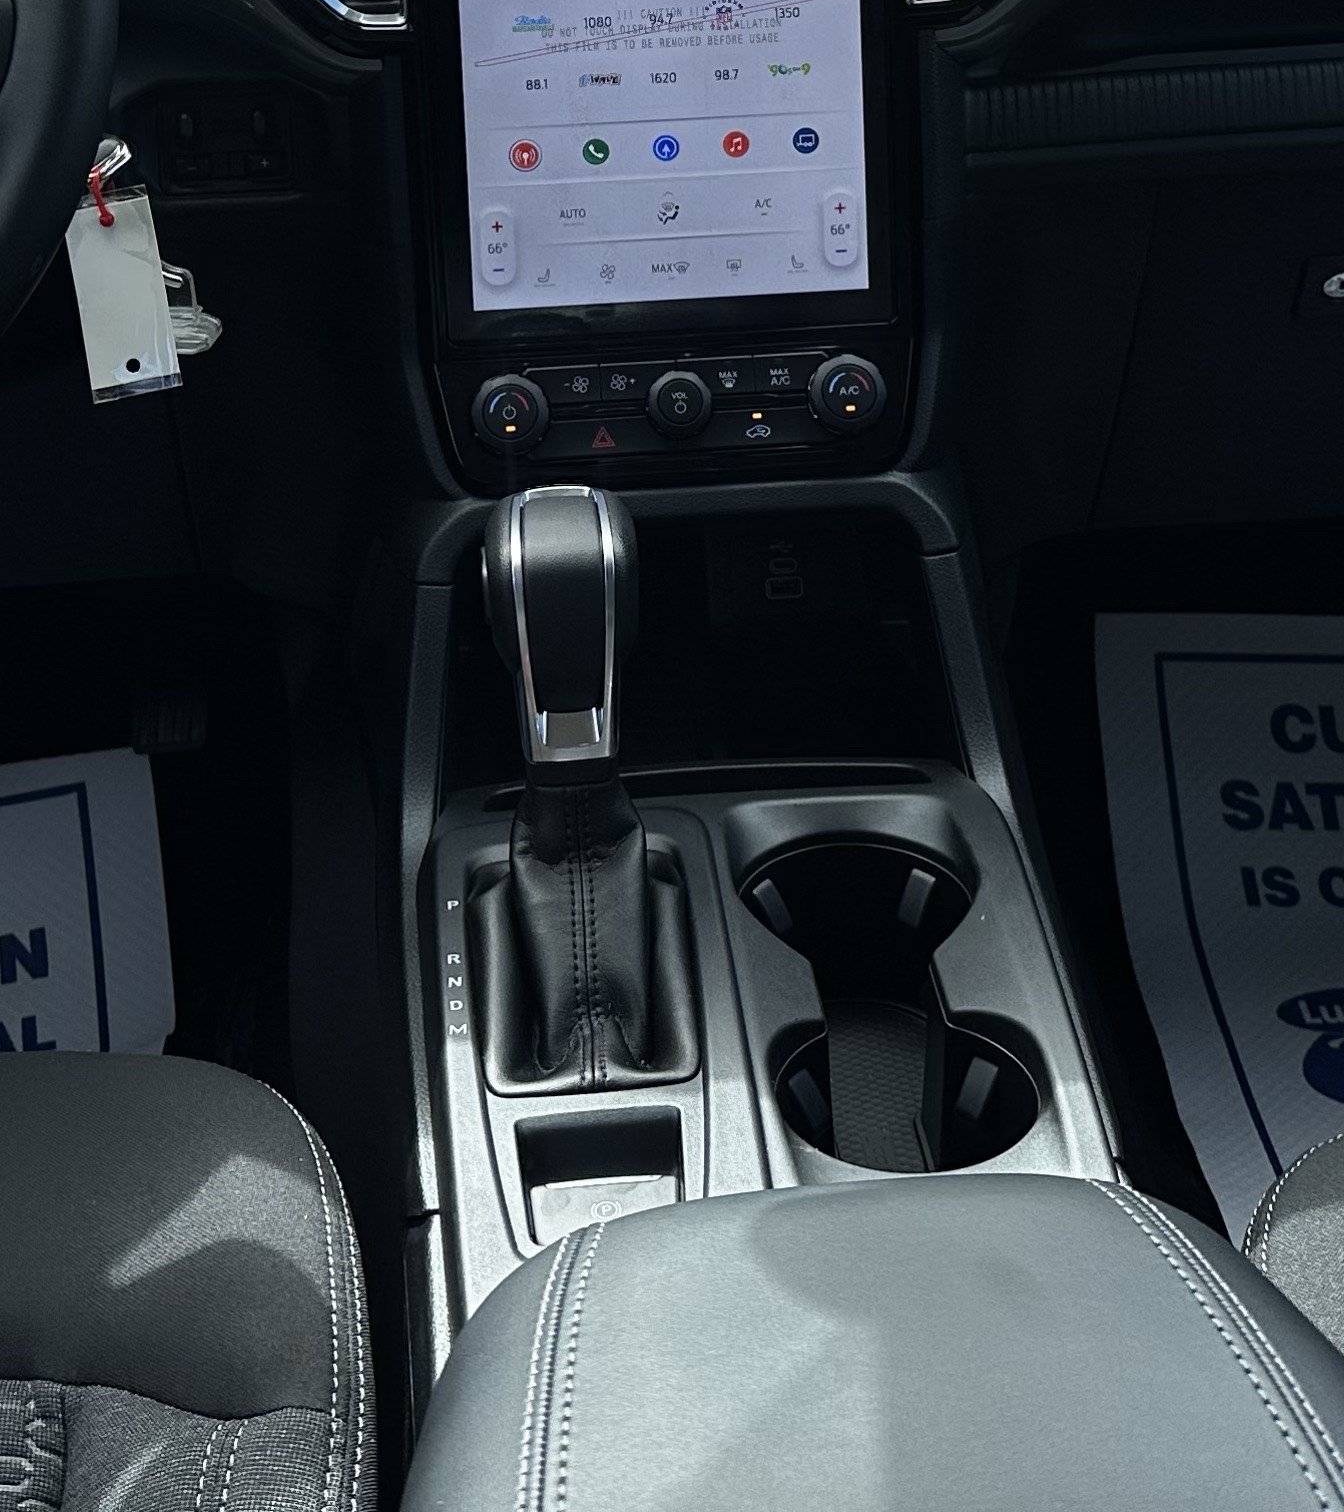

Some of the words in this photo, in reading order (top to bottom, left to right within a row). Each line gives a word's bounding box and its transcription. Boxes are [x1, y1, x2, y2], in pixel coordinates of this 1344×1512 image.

[640, 6, 682, 20] CAUTION
[583, 16, 612, 29] 1080
[649, 12, 674, 26] 94.7
[560, 26, 577, 38] NOT
[606, 40, 617, 50] IS
[624, 39, 635, 49] TO
[642, 38, 654, 49] BE
[659, 36, 701, 48] REMOVED
[707, 35, 744, 46] BEFORE
[749, 33, 779, 44] USAGE
[526, 78, 548, 90] 88.1
[650, 72, 677, 84] 1620
[714, 69, 739, 81] 98.7
[560, 209, 587, 219] AUTO
[754, 198, 772, 209] A/C
[651, 263, 674, 274] MAX
[718, 370, 738, 380] MAX
[769, 367, 789, 376] MAX
[770, 376, 791, 387] A/C
[839, 385, 860, 396] A/C
[1244, 865, 1303, 908] IS
[445, 899, 460, 912] P
[447, 952, 462, 965] R
[447, 975, 464, 989] N
[449, 999, 464, 1012] D
[448, 1022, 469, 1036] M
